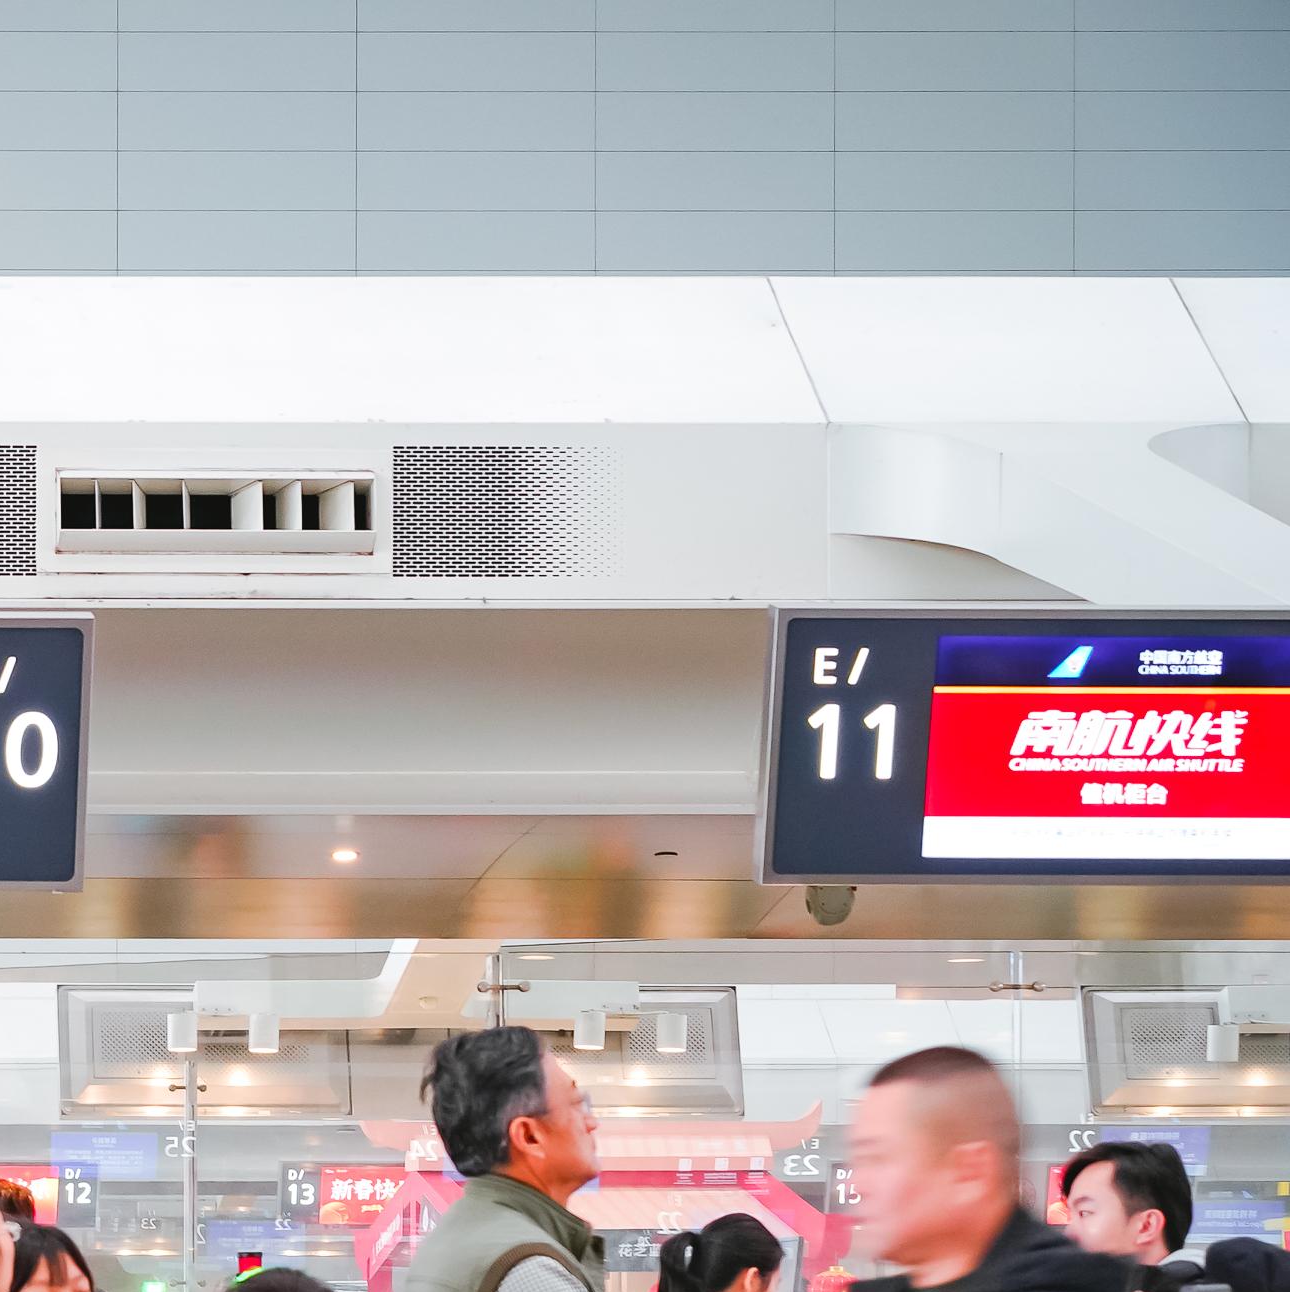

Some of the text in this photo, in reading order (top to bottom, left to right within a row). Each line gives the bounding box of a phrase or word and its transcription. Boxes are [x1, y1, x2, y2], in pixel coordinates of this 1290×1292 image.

[812, 647, 871, 686] E/
[1138, 664, 1222, 675] CHINA SOUTHERN
[807, 702, 898, 781] 11
[1009, 709, 1249, 756] 南航快线
[1008, 757, 1245, 772] CHINA SOUTHERN AIR SHUTTLE
[1080, 783, 1168, 805] 值机柜台
[65, 1182, 92, 1204] 12
[288, 1183, 315, 1205] 13
